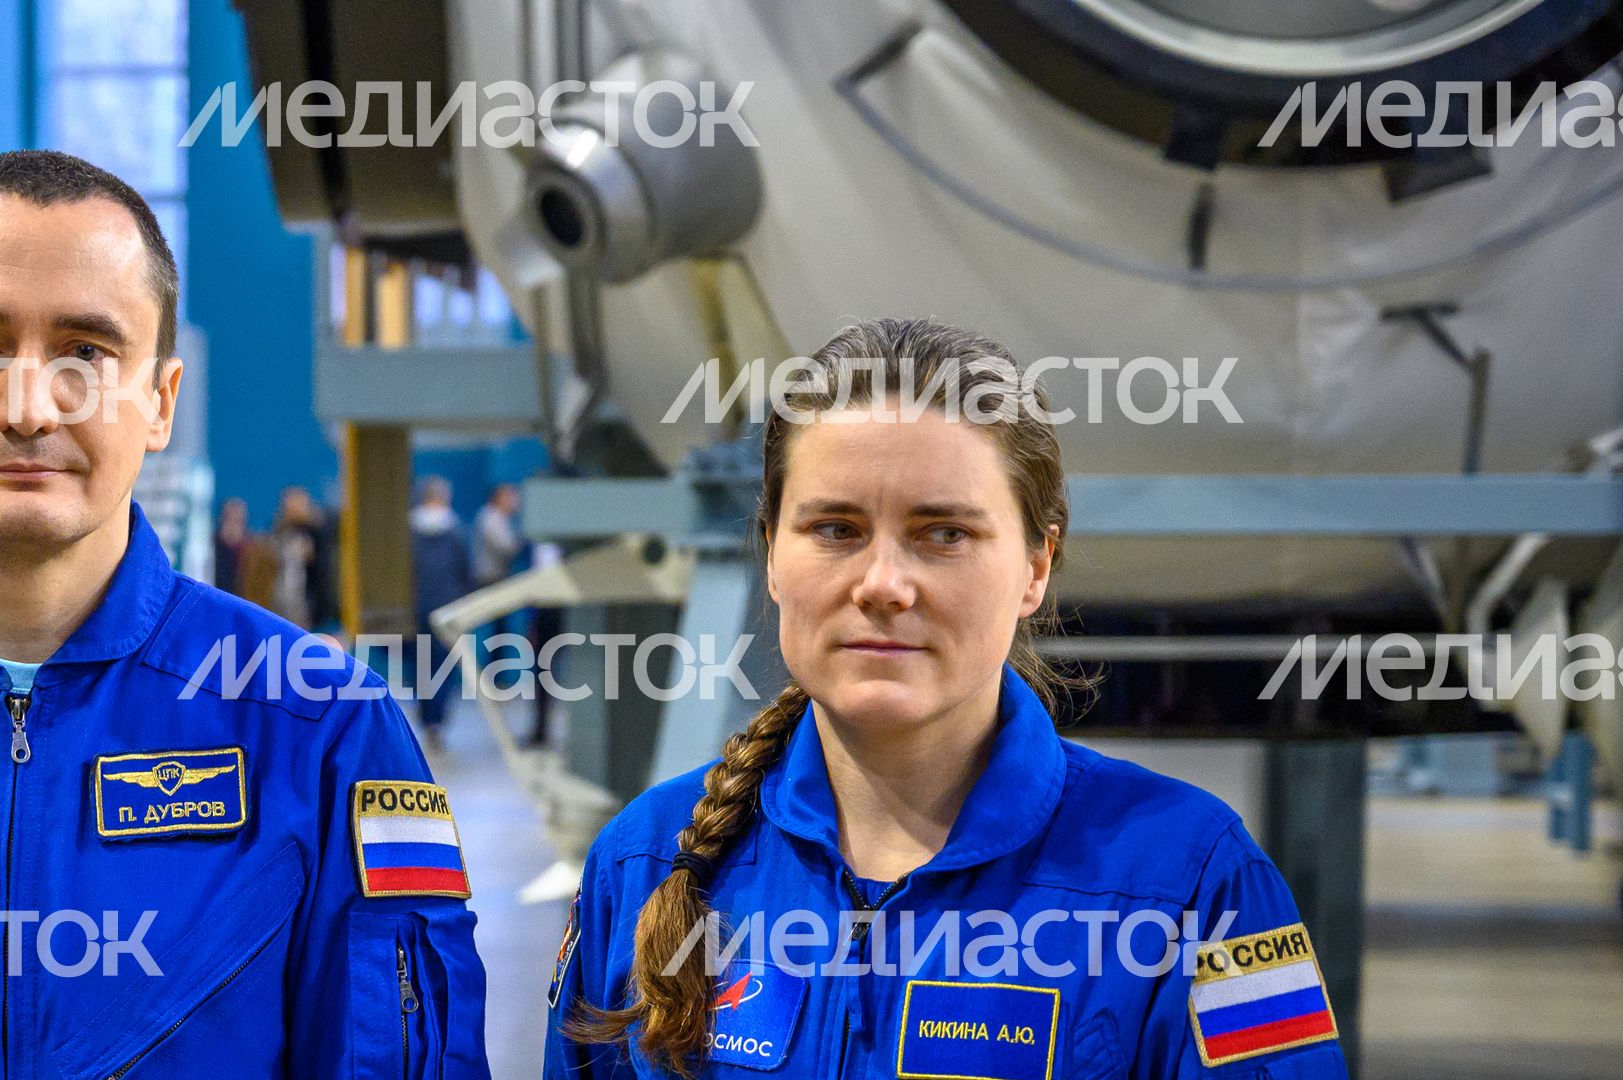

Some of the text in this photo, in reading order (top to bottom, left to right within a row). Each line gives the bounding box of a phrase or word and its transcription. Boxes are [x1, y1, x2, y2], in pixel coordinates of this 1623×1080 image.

[158, 767, 180, 782] ЦПК
[119, 801, 226, 824] П. ДУБРОВ
[361, 788, 450, 815] РОССИЯ
[705, 1032, 773, 1057] ОСМОС
[919, 1020, 1035, 1045] КИКИНА А.Ю.
